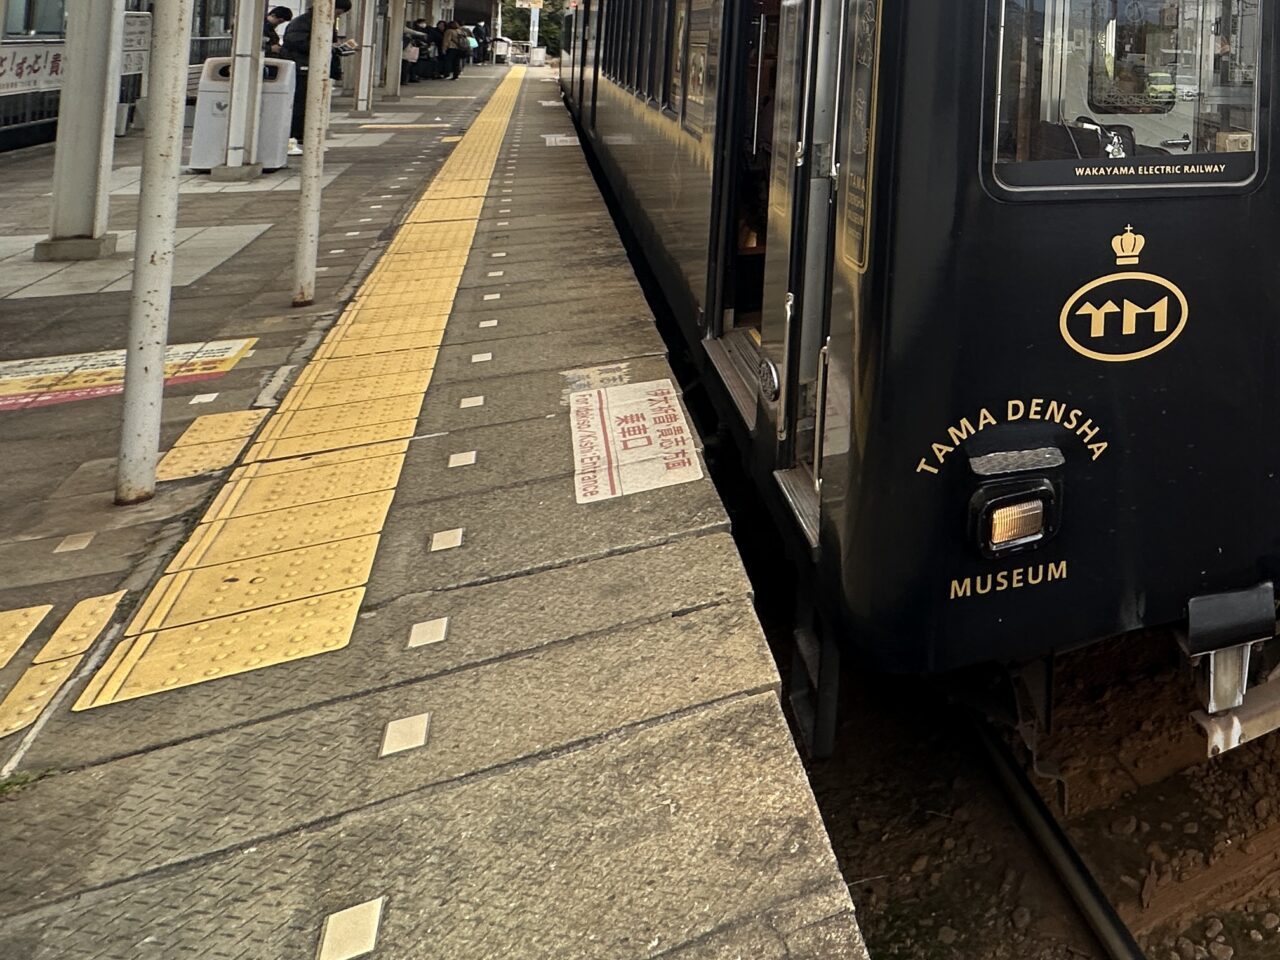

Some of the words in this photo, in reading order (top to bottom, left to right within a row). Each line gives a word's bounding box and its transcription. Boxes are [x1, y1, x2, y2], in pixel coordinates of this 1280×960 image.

[1075, 166, 1135, 176] WAKAYAMA
[1138, 165, 1181, 175] ELECTRIC
[1183, 164, 1226, 174] RAILWAY
[1075, 296, 1168, 337] TM
[575, 394, 592, 407] For
[615, 412, 653, 451] 乗車口
[916, 408, 997, 475] TAMA
[1007, 398, 1109, 461] DENSHA
[950, 560, 1067, 599] MUSEUM
